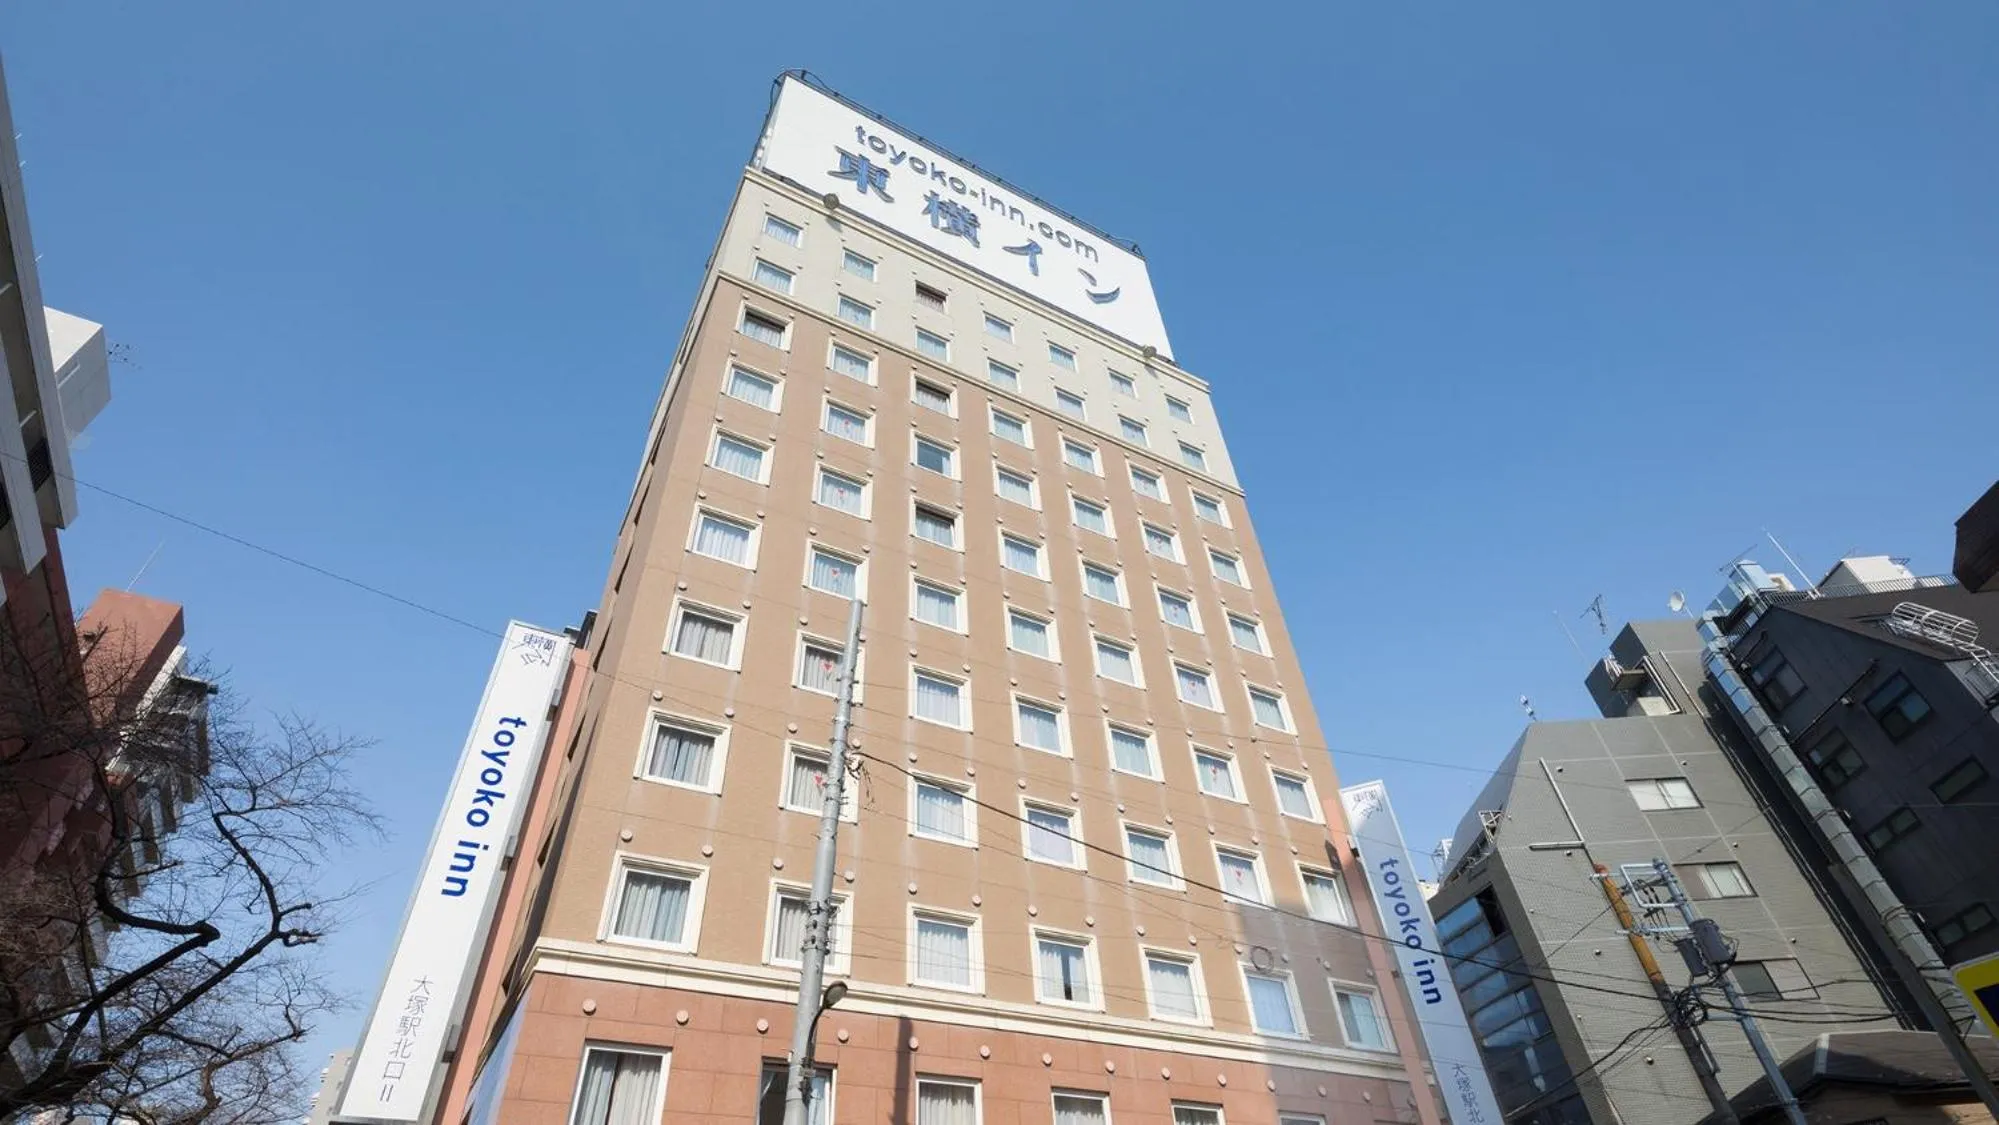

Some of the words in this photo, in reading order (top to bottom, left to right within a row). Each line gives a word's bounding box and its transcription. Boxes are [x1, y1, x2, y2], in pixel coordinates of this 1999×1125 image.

[827, 144, 1121, 304] 東横イン
[854, 124, 1099, 263] toyoko-inn.com
[466, 716, 527, 828] toyoko
[441, 840, 489, 898] inn
[1379, 857, 1422, 949] toyoko
[1413, 957, 1442, 1005] inn
